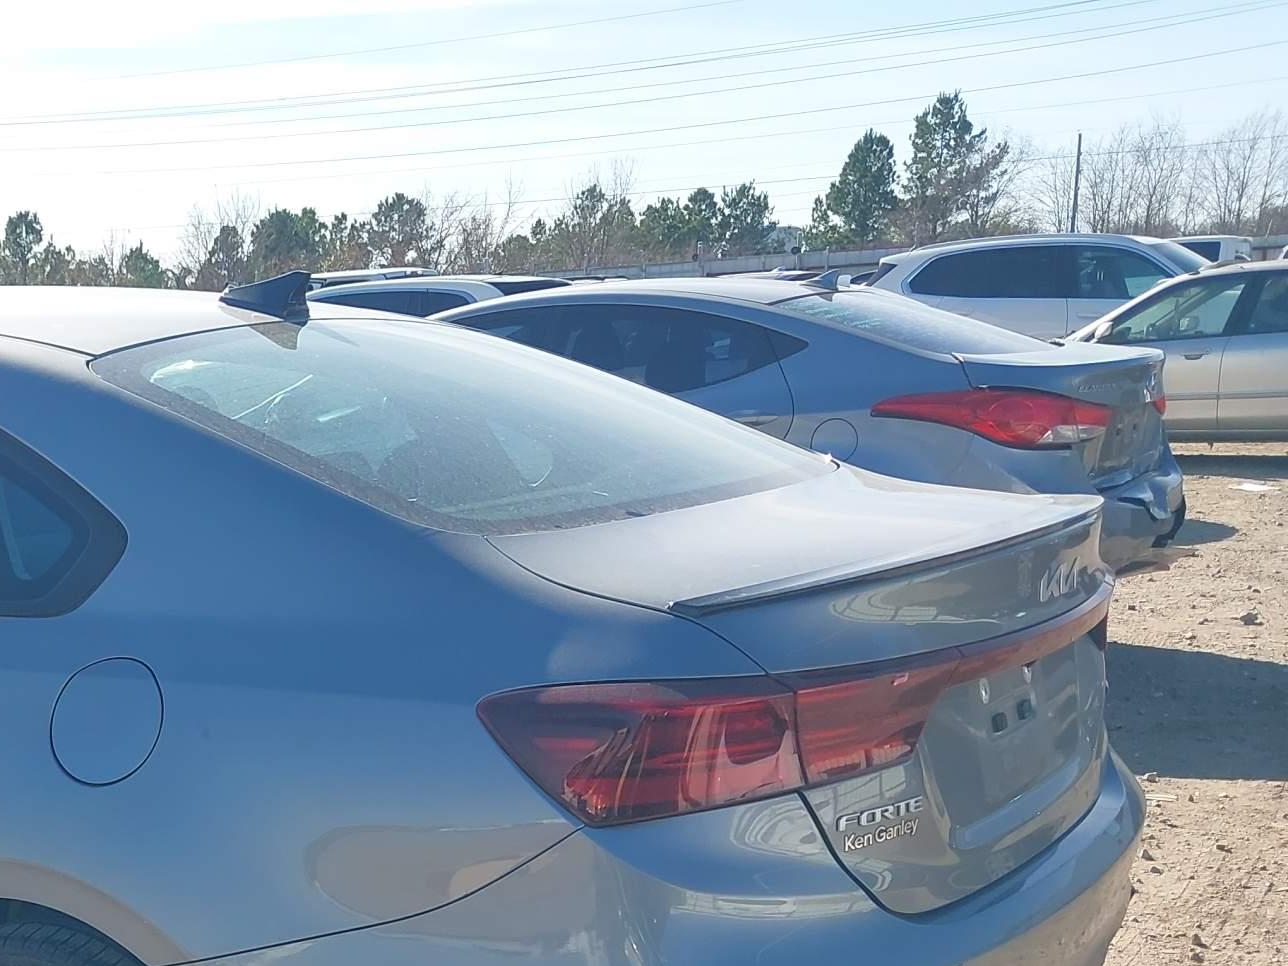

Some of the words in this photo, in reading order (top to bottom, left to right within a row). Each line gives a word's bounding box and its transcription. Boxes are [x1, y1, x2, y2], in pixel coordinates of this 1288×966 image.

[836, 795, 923, 832] FORTE
[844, 834, 873, 853] Ken
[875, 818, 919, 843] Ganley
